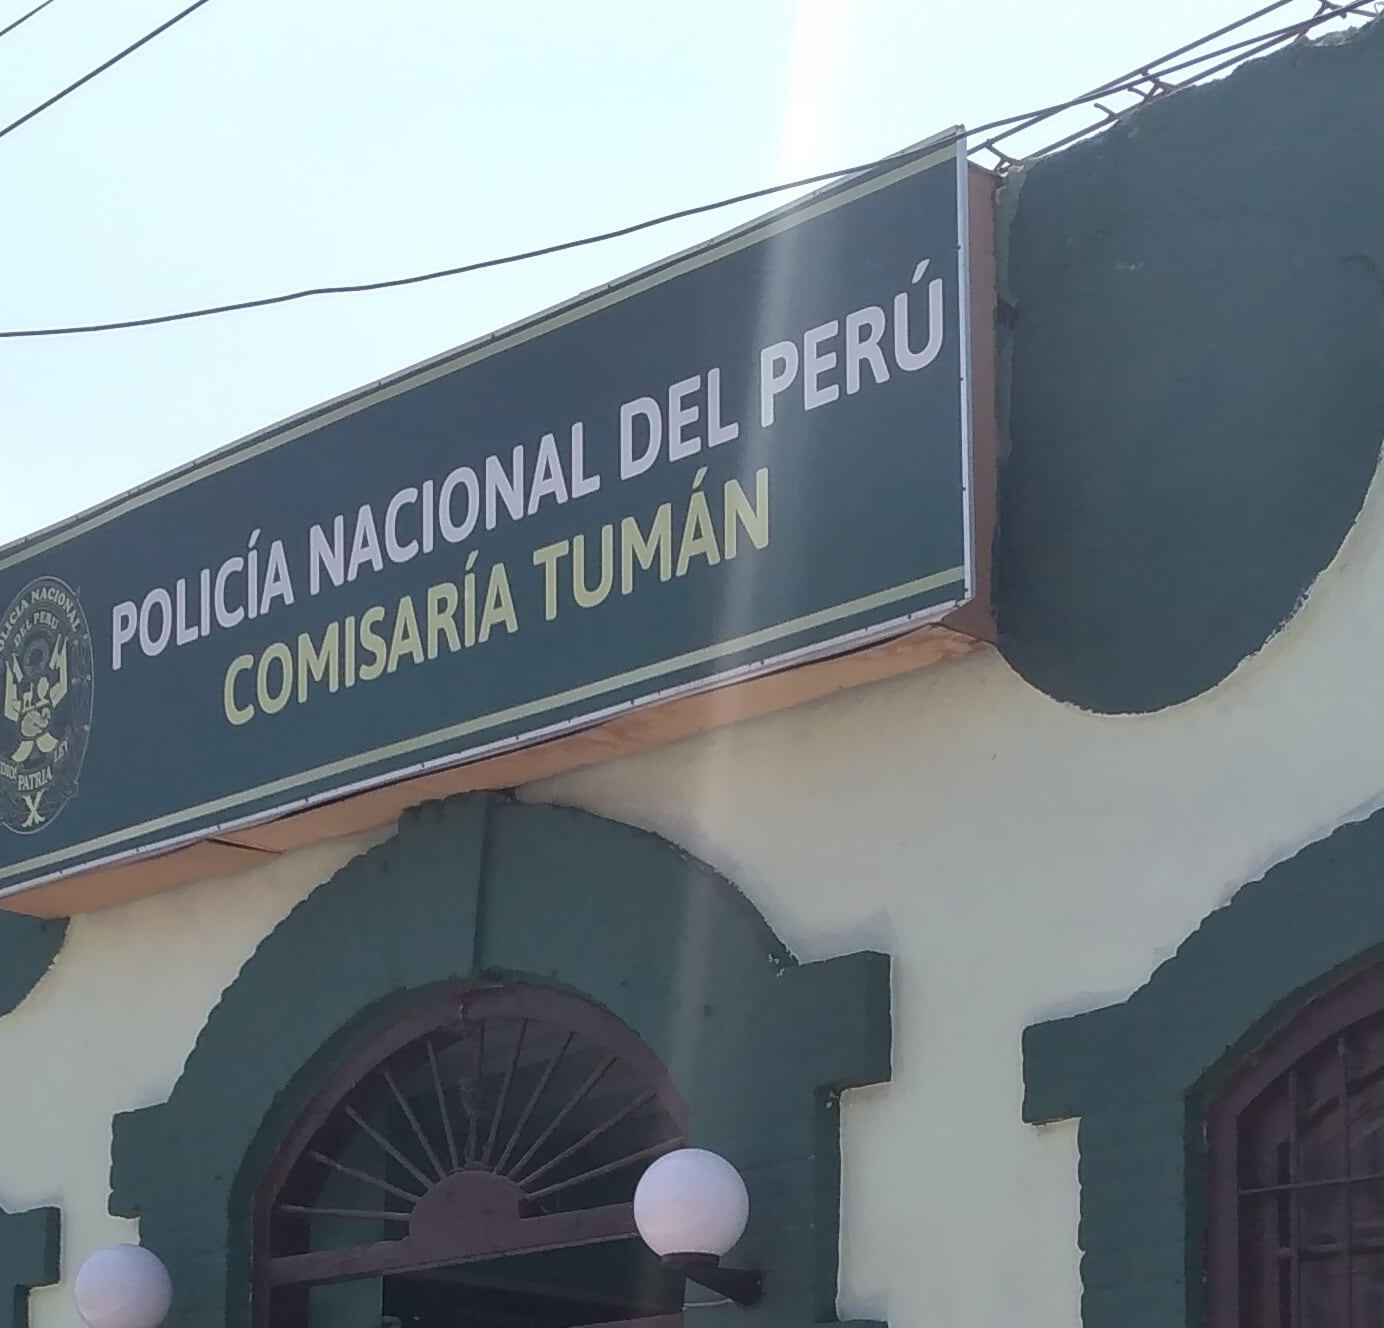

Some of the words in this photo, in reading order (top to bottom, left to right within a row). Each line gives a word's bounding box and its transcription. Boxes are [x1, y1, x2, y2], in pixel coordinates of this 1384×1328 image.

[111, 528, 296, 671] POLICÍA
[308, 420, 602, 597] NACIONAL
[619, 366, 740, 481] DEL
[759, 257, 945, 429] PERÚ
[31, 587, 81, 632] NACIONAL
[222, 549, 520, 727] COMISARÍA
[531, 465, 772, 622] TUMÁN
[13, 619, 33, 648] DEL
[33, 611, 60, 630] PERU
[17, 765, 52, 791] PATRIA
